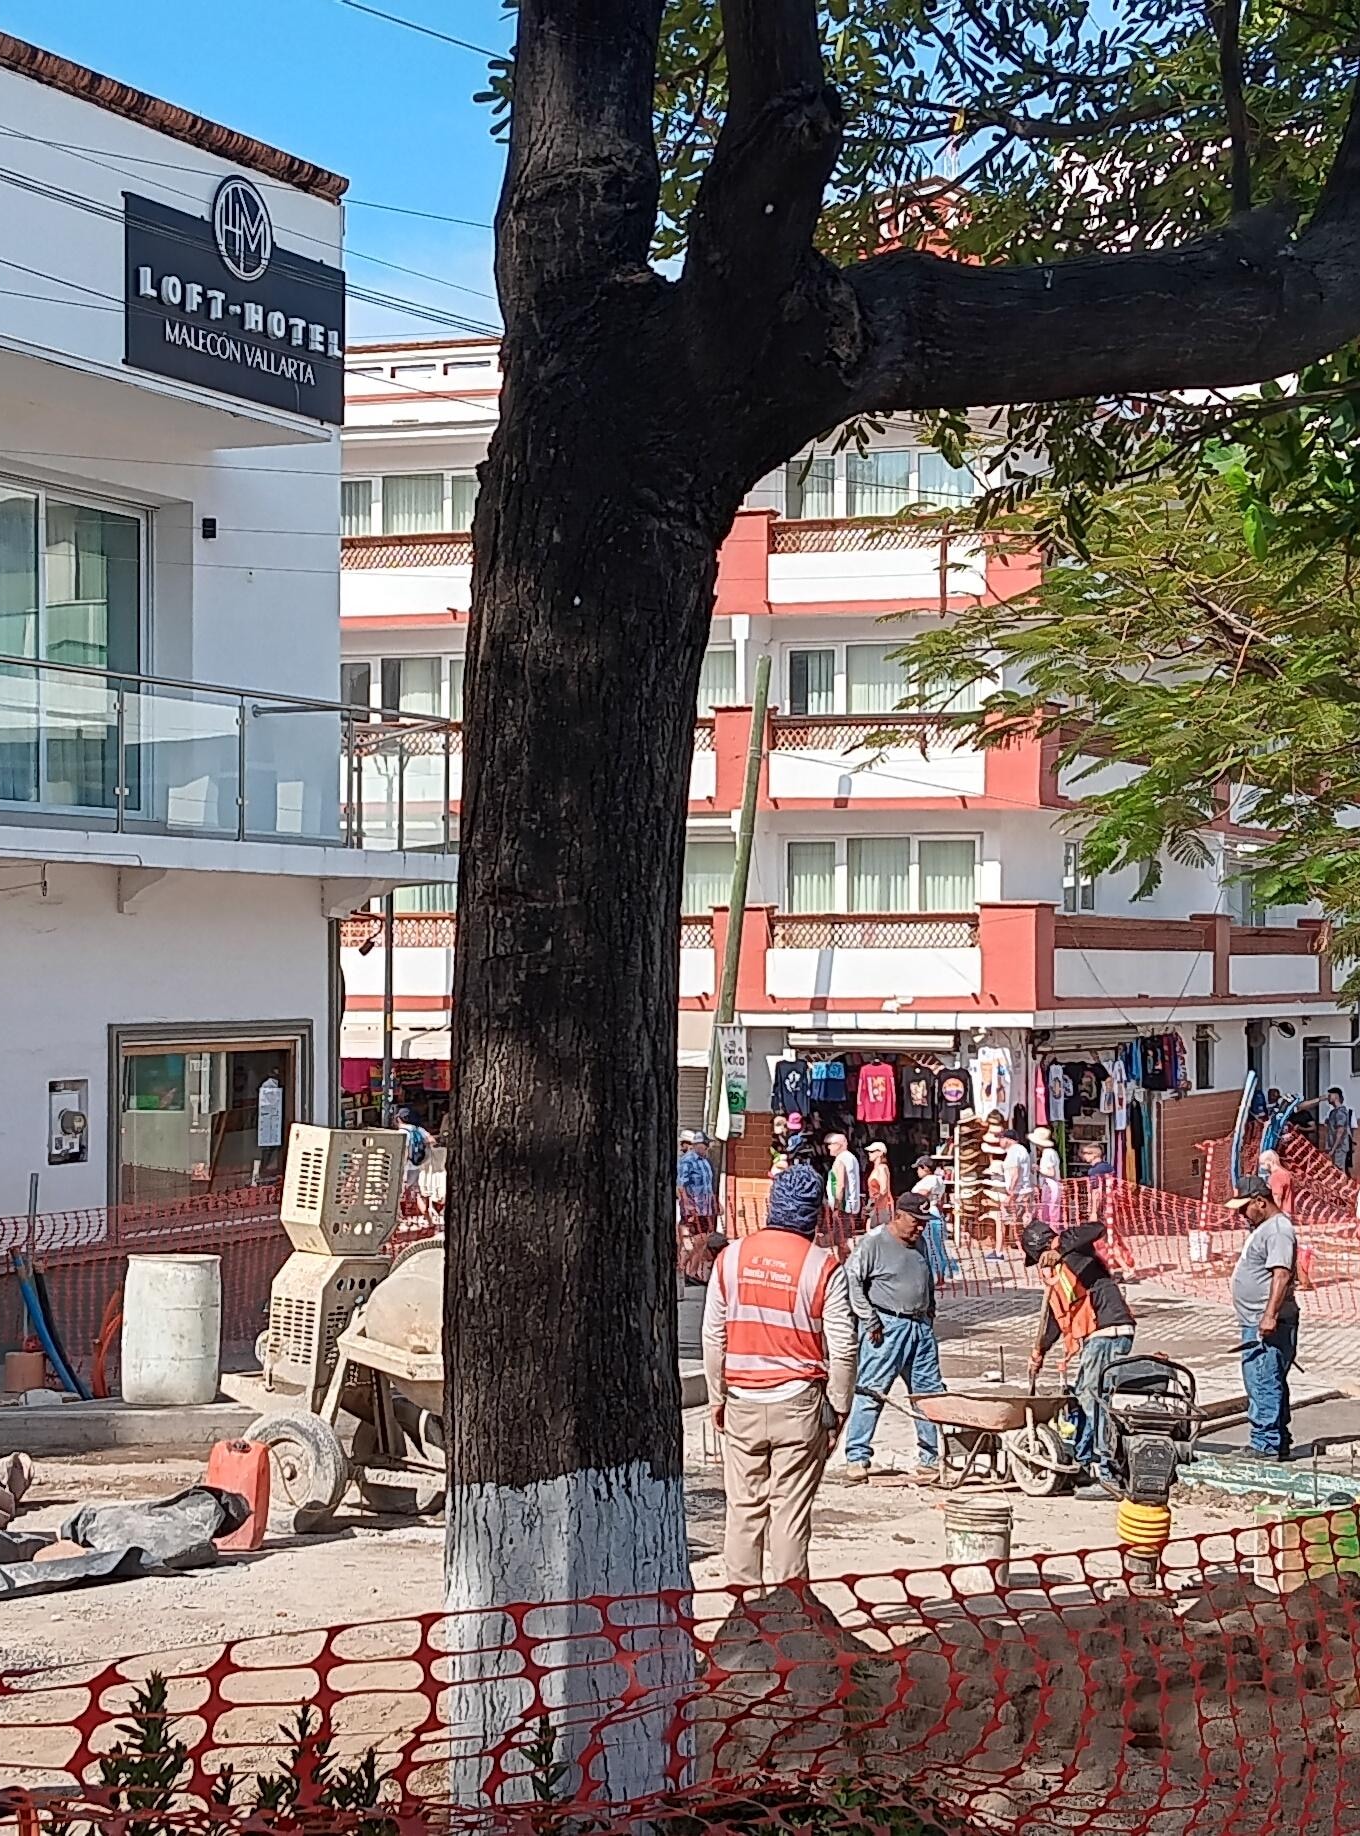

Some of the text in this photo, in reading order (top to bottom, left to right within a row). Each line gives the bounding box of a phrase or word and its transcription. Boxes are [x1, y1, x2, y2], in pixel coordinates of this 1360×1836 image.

[138, 266, 343, 358] LOFT-HOTEL
[164, 318, 316, 386] MALECÓN VALLARTA
